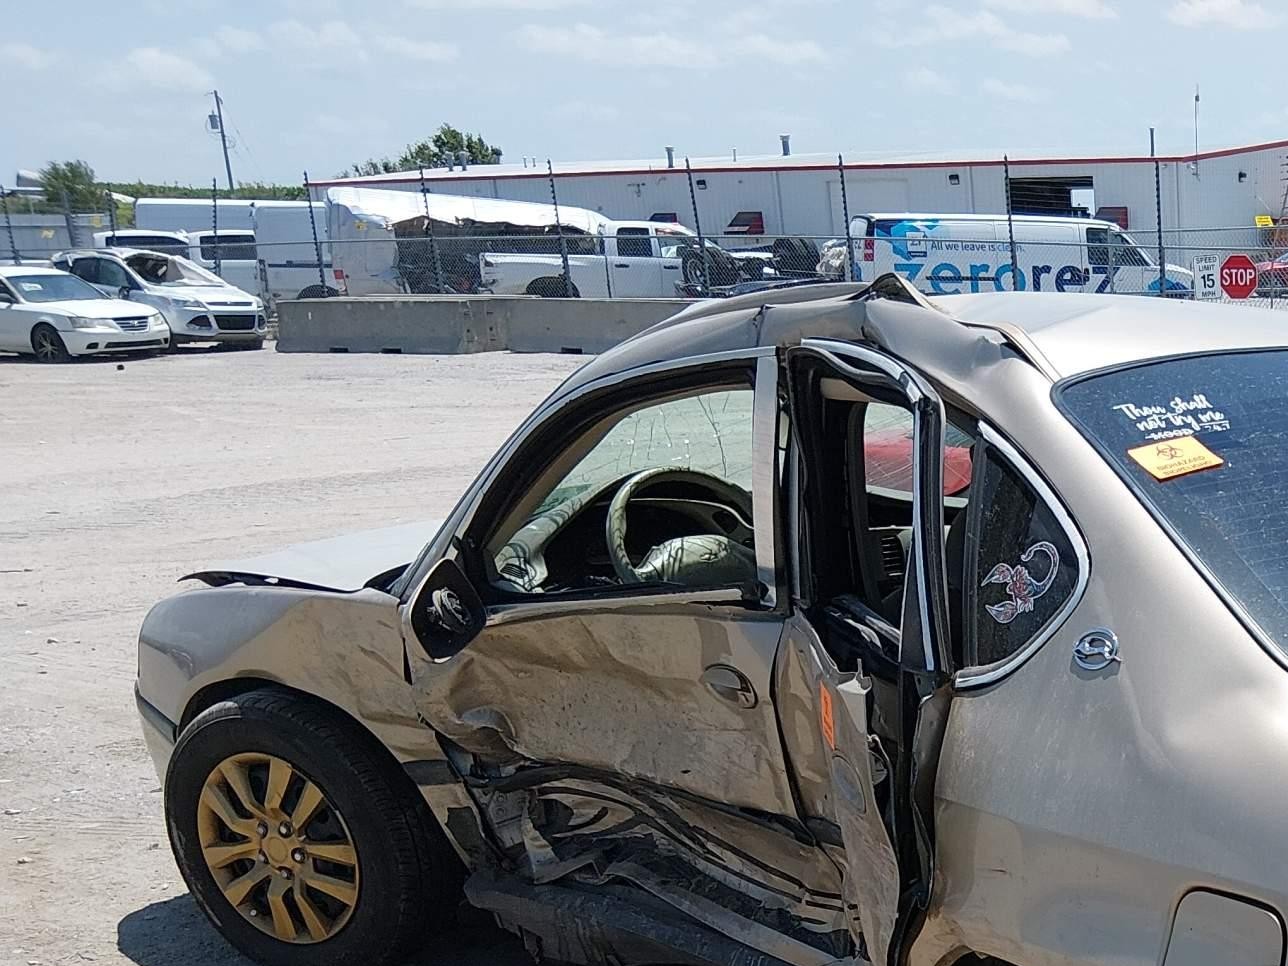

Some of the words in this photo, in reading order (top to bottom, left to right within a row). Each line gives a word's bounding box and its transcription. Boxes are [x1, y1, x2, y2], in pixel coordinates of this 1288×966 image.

[930, 241, 944, 251] All
[944, 243, 960, 251] we
[961, 241, 986, 251] leave
[988, 242, 996, 251] is
[997, 242, 1025, 252] clen.
[1195, 256, 1217, 265] SPEED
[1198, 264, 1215, 272] LIMIT
[893, 261, 1121, 295] zerorez
[1201, 273, 1215, 289] 15
[1222, 268, 1255, 286] STOP
[1201, 290, 1216, 298] MPH
[1112, 403, 1166, 420] Thou
[1170, 393, 1213, 413] shall
[1135, 413, 1167, 432] not
[1162, 412, 1201, 431] try
[1198, 411, 1225, 423] me
